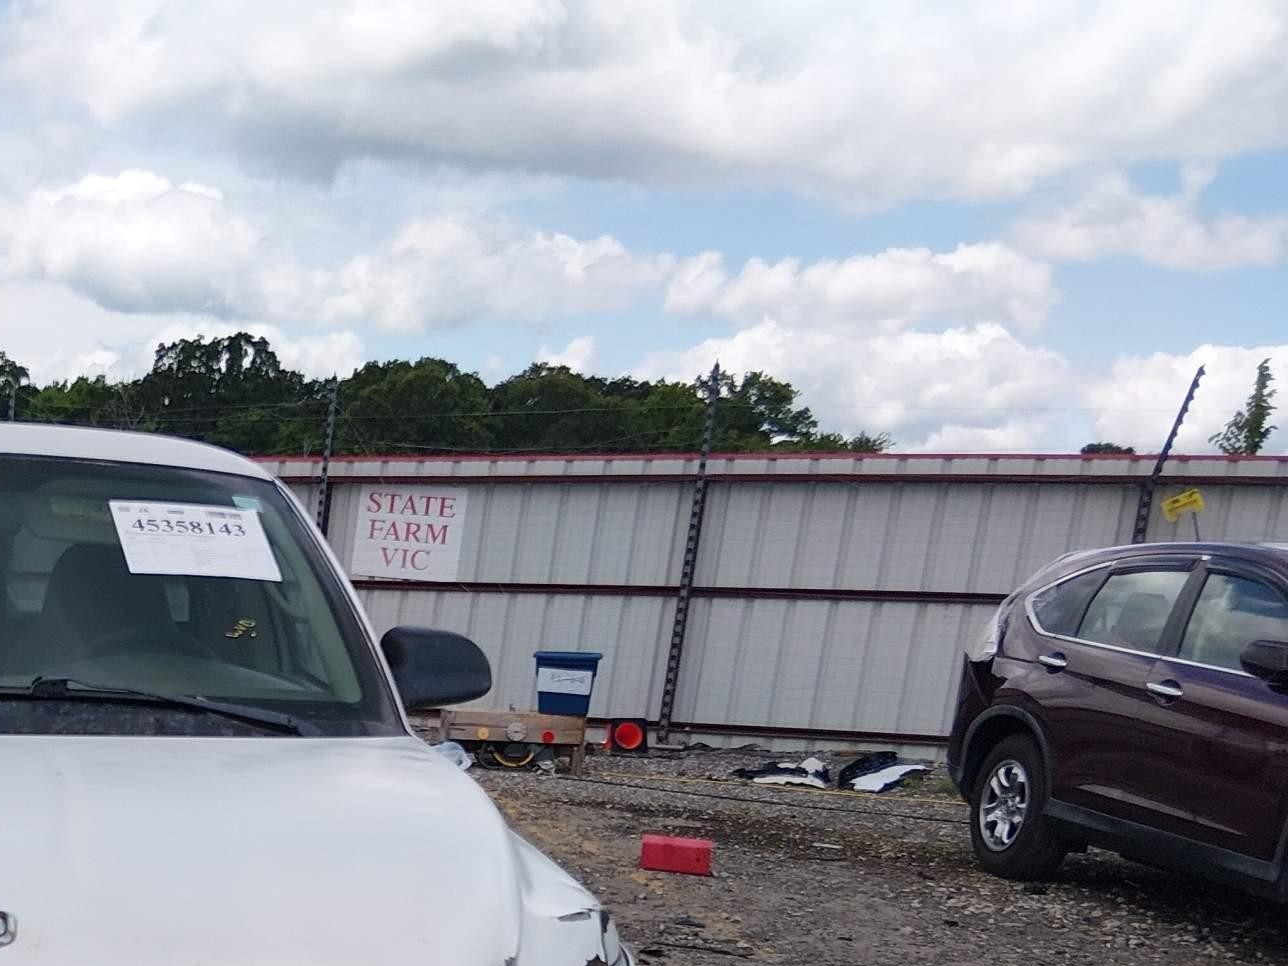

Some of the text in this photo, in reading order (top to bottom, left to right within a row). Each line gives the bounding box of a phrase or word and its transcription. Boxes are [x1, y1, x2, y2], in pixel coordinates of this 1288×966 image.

[367, 491, 457, 518] STATE
[131, 518, 247, 537] 45358143
[368, 519, 450, 545] FARM
[380, 547, 430, 571] VIC
